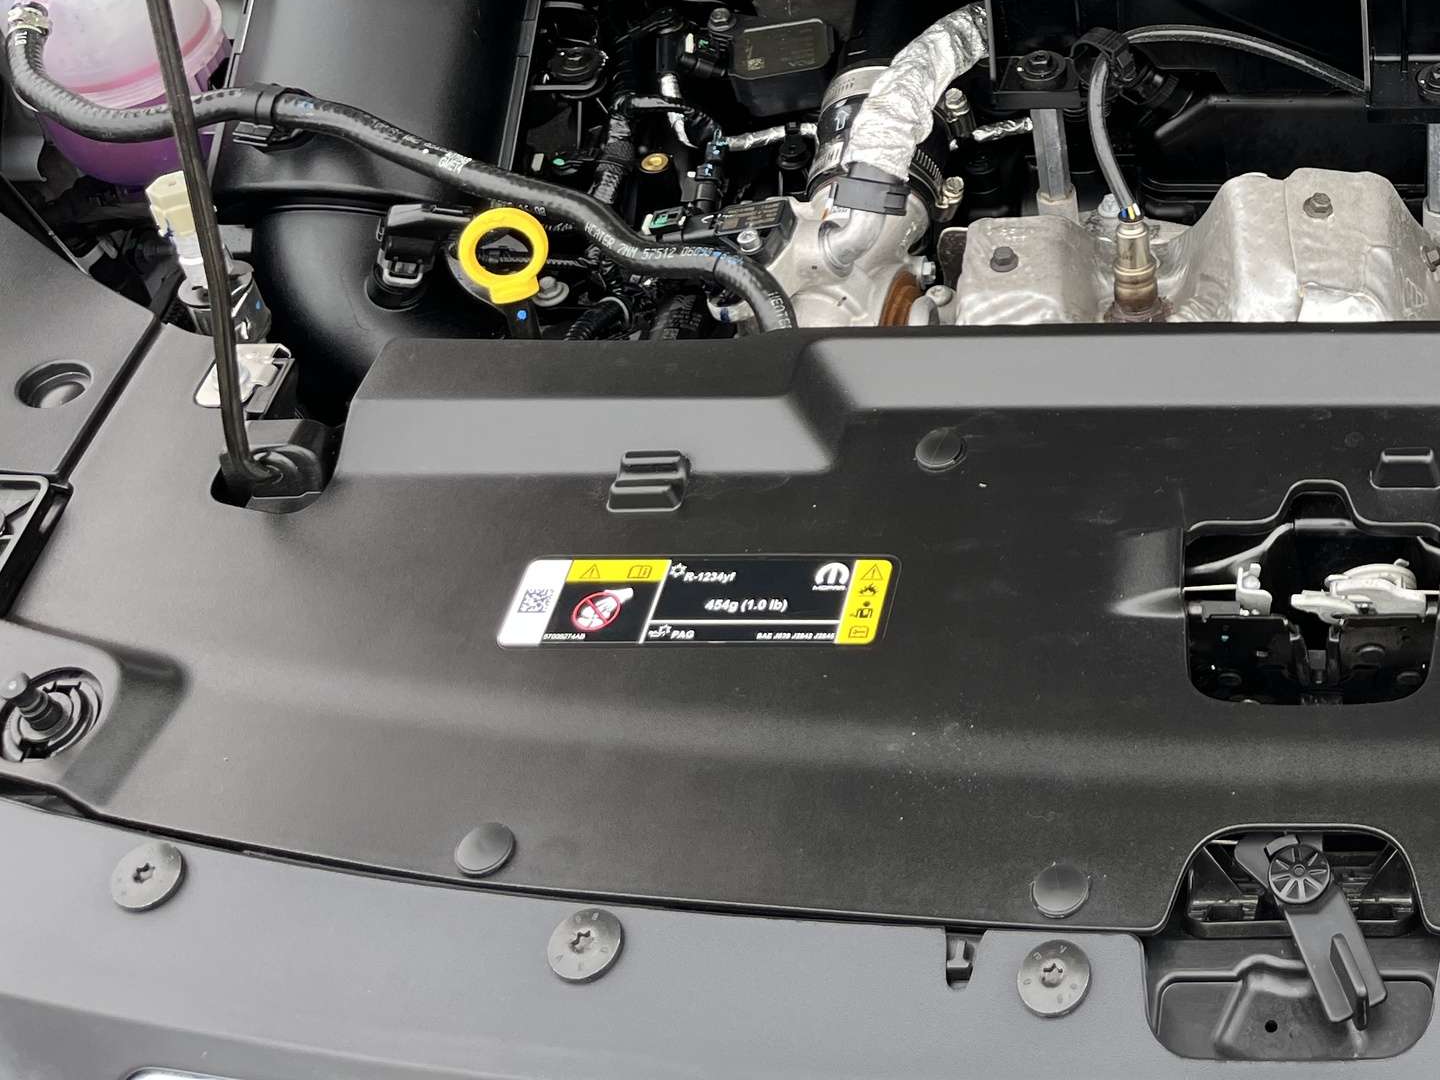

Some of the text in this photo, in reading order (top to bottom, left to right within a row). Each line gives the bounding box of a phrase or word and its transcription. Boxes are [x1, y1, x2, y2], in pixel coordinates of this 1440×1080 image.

[585, 223, 613, 251] HEATER
[683, 571, 737, 584] R-1234yf
[704, 598, 789, 613] 454g (1.0 lb)
[670, 630, 695, 640] PAG
